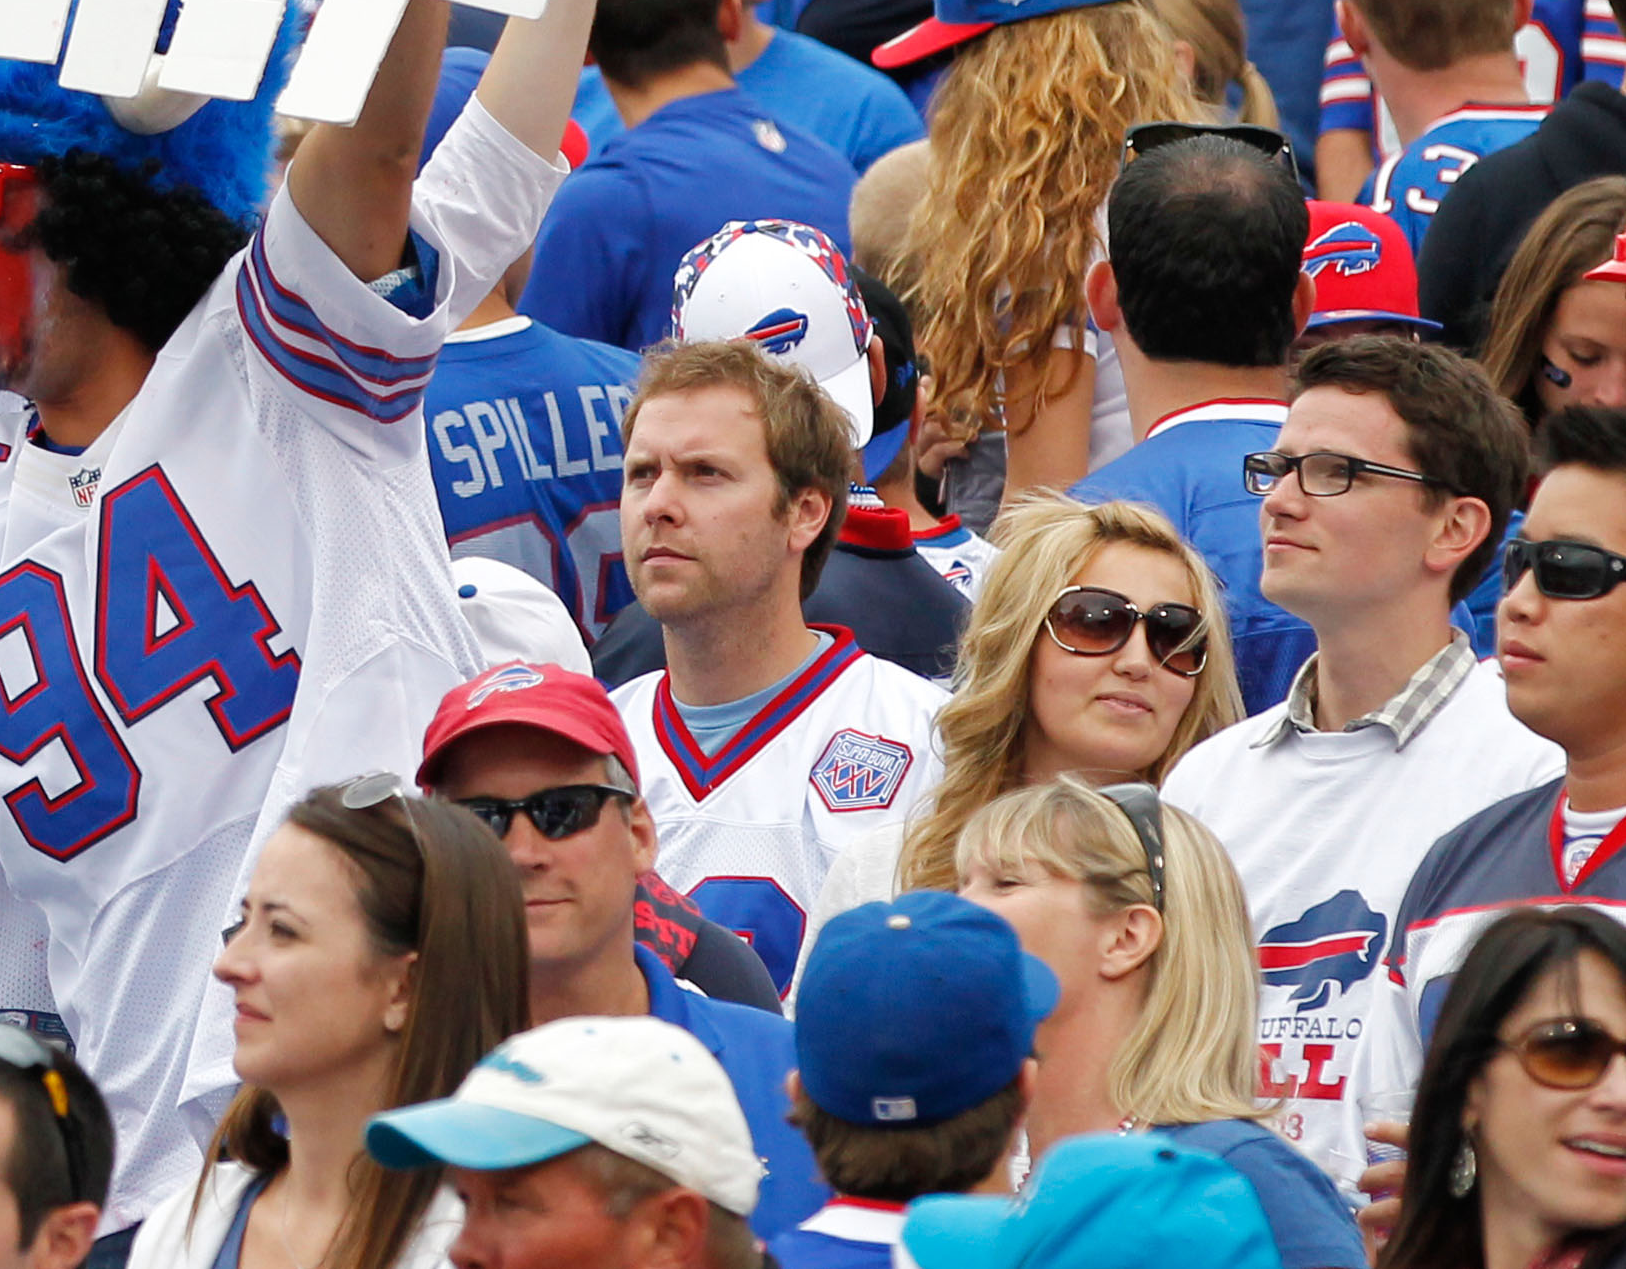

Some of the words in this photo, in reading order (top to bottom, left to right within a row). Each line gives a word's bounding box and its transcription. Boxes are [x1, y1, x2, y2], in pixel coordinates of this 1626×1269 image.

[838, 741, 872, 760] SUPER
[867, 750, 897, 771] BOWL
[823, 757, 889, 797] XXV
[1260, 1016, 1363, 1040] UFFALO
